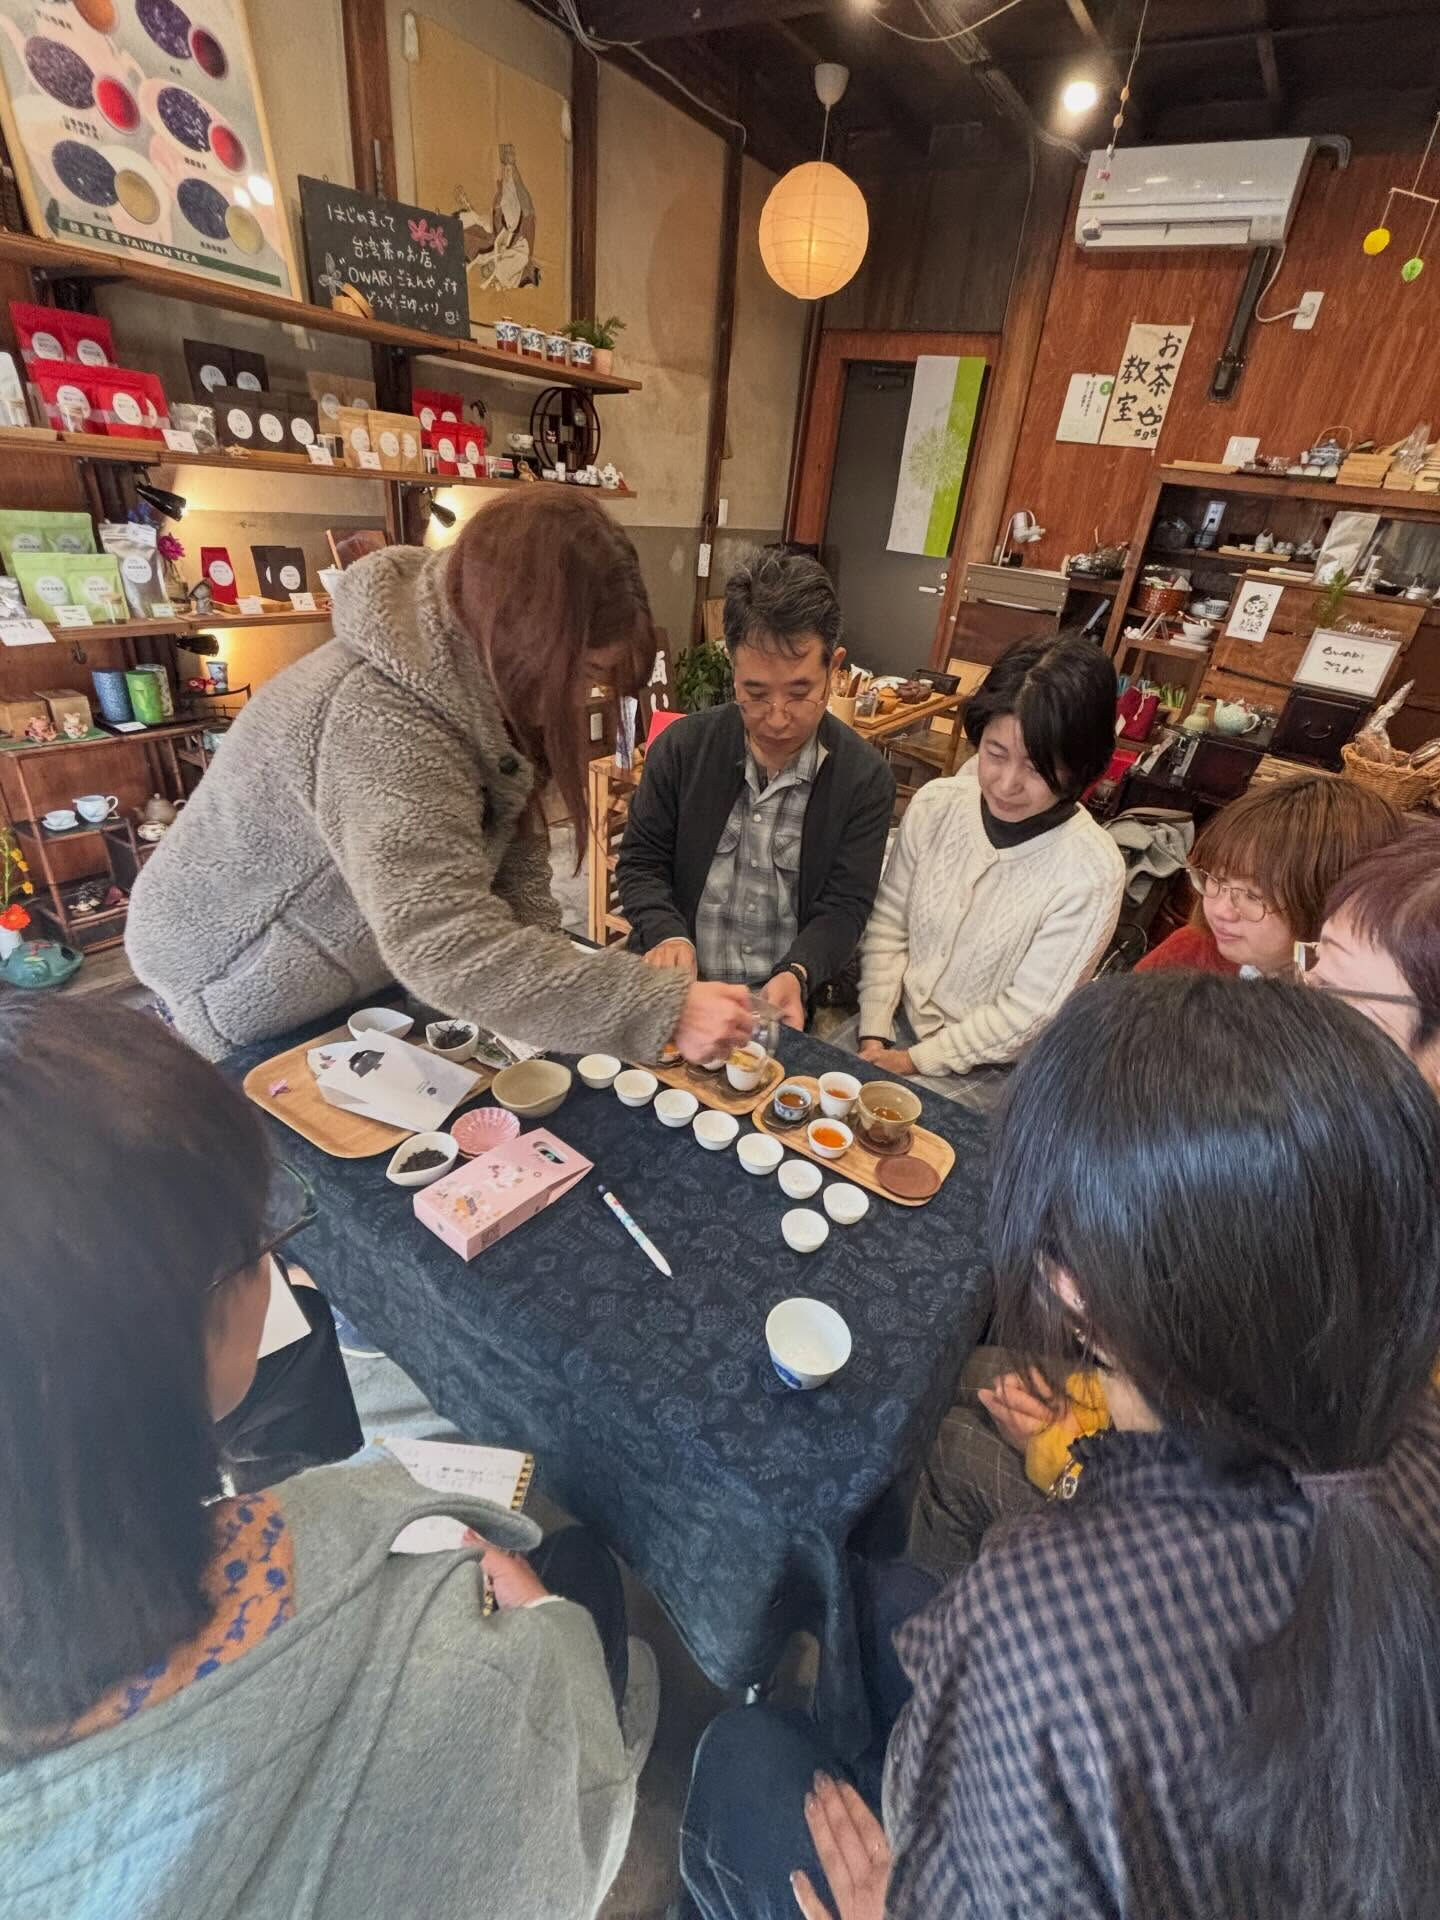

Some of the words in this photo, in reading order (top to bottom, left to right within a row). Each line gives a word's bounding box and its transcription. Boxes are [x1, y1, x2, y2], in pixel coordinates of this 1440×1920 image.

[327, 204, 396, 232] はじめまして
[124, 235, 172, 257] TAIWAN
[175, 247, 199, 264] TEA
[1147, 331, 1182, 397] お茶
[1112, 354, 1151, 423] 教室
